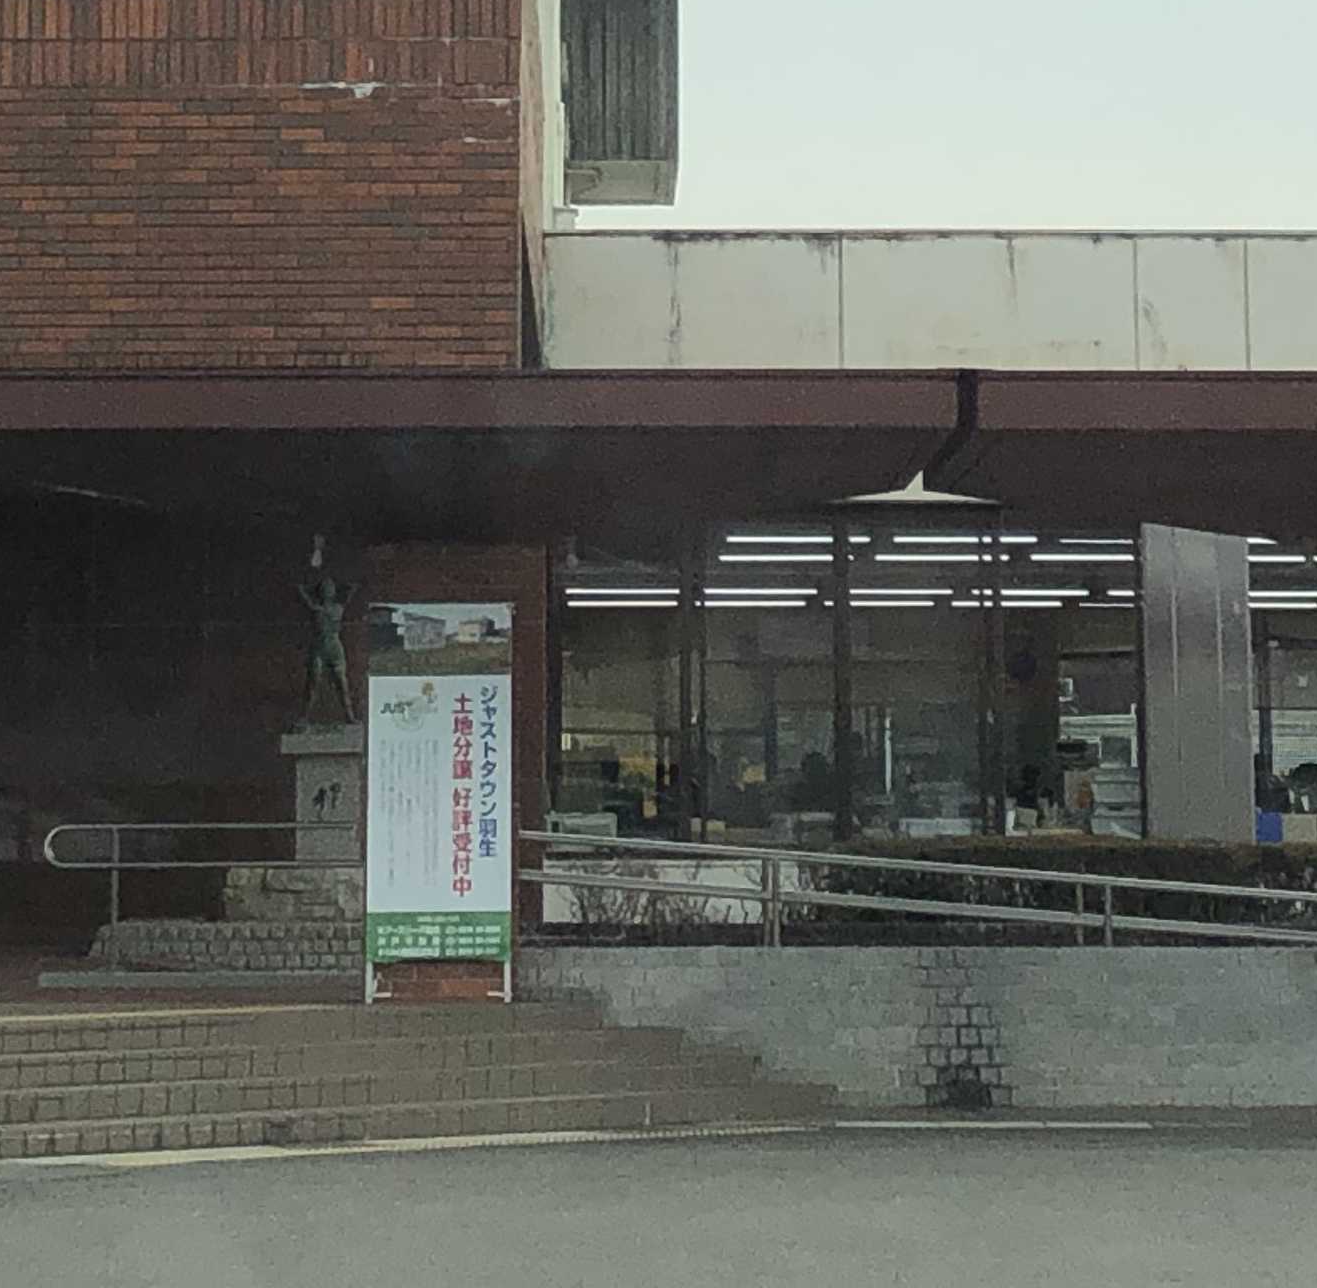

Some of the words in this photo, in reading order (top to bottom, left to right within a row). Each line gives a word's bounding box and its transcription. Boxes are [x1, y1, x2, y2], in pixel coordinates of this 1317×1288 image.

[452, 787, 473, 897] 好評受付中
[479, 685, 498, 858] ジャストタウン羽生
